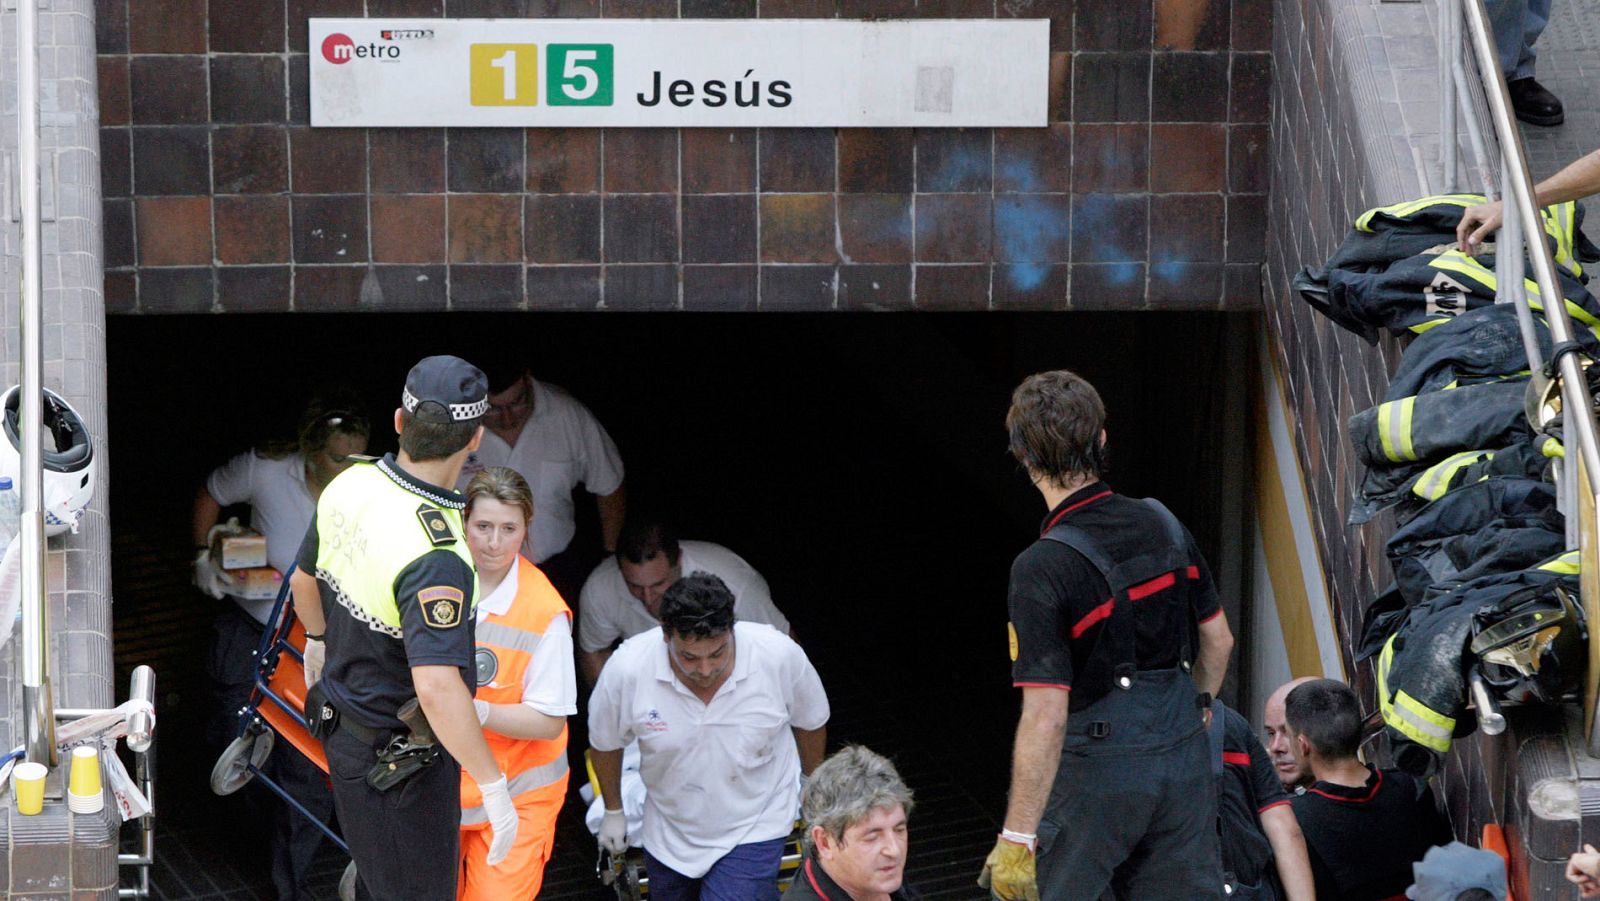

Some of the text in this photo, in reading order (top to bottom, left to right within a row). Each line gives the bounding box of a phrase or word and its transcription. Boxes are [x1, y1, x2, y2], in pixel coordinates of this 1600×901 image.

[333, 41, 400, 59] metro
[491, 50, 792, 107] 1 5 Jesús
